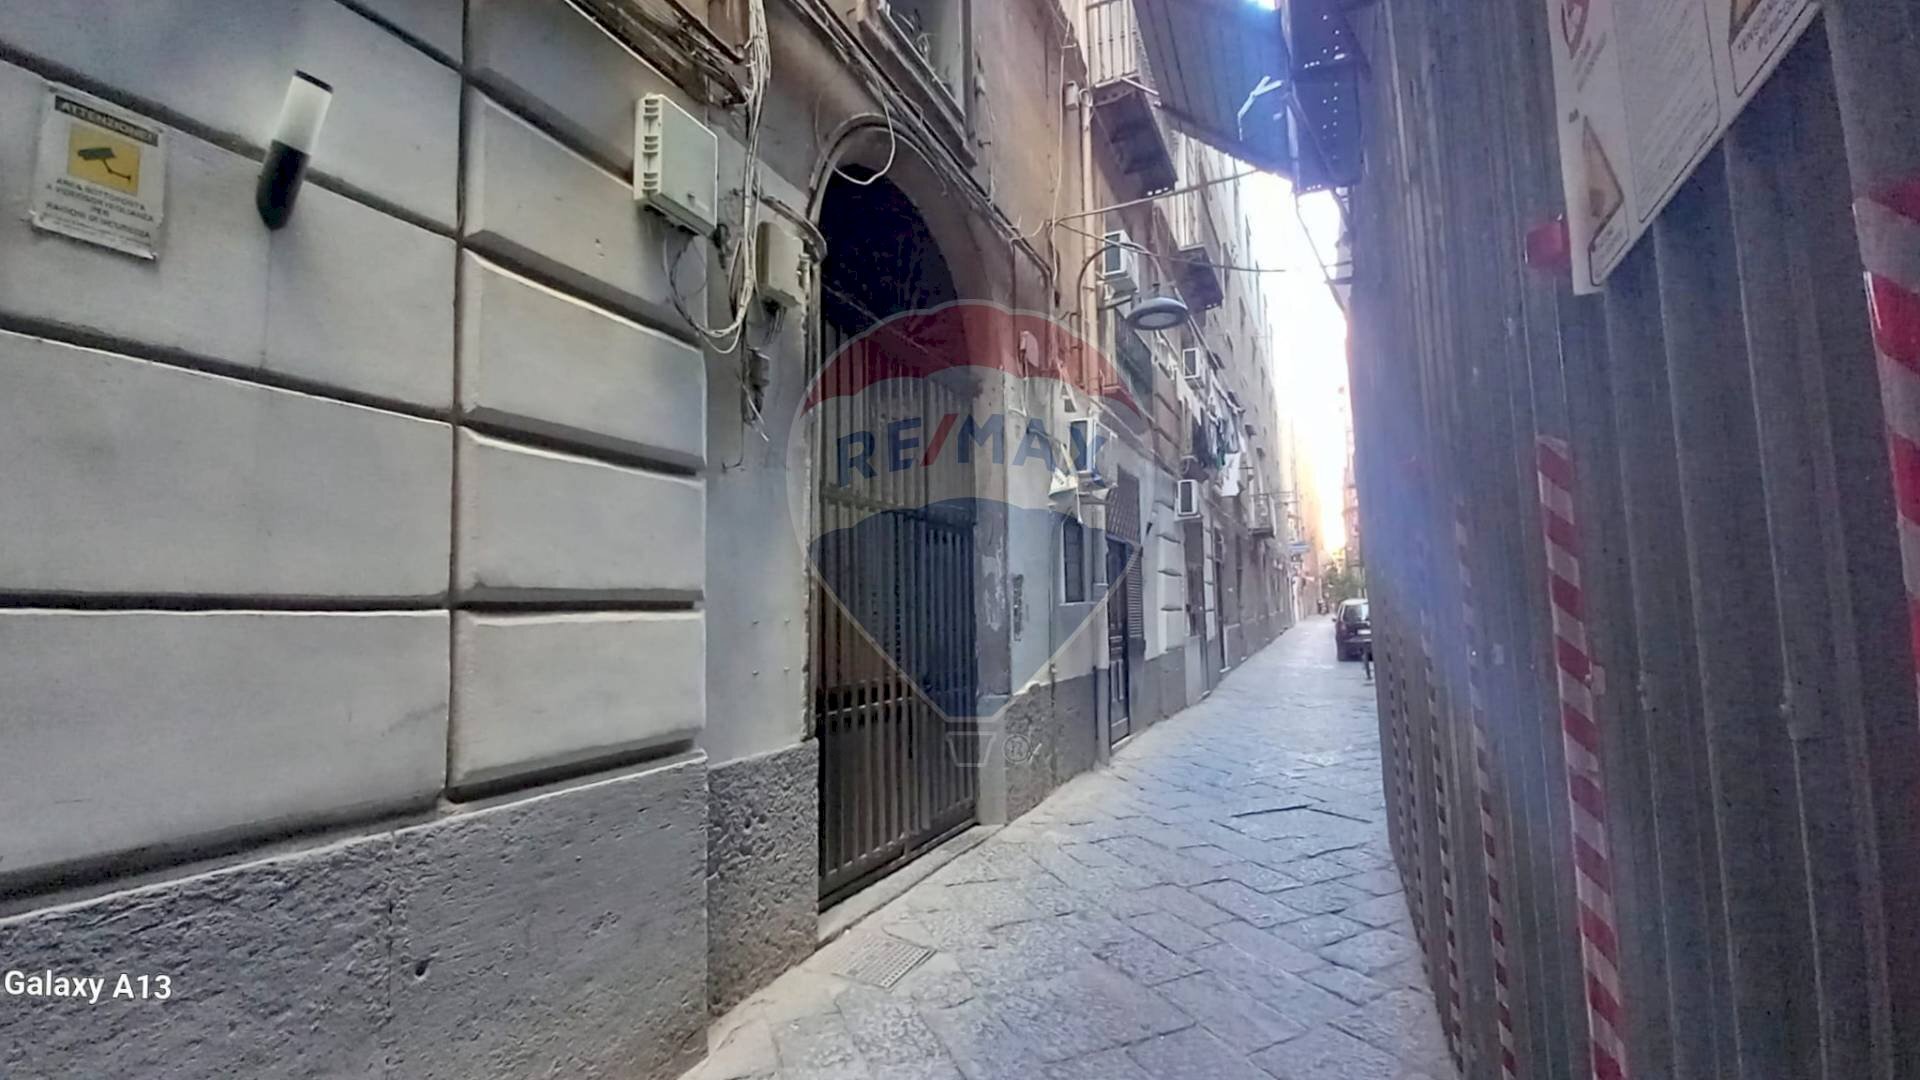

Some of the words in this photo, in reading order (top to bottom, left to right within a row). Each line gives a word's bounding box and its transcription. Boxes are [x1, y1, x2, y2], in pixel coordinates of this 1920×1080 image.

[56, 177, 83, 191] AREA
[84, 186, 145, 211] SOTTOPOSTA
[91, 206, 109, 217] PER
